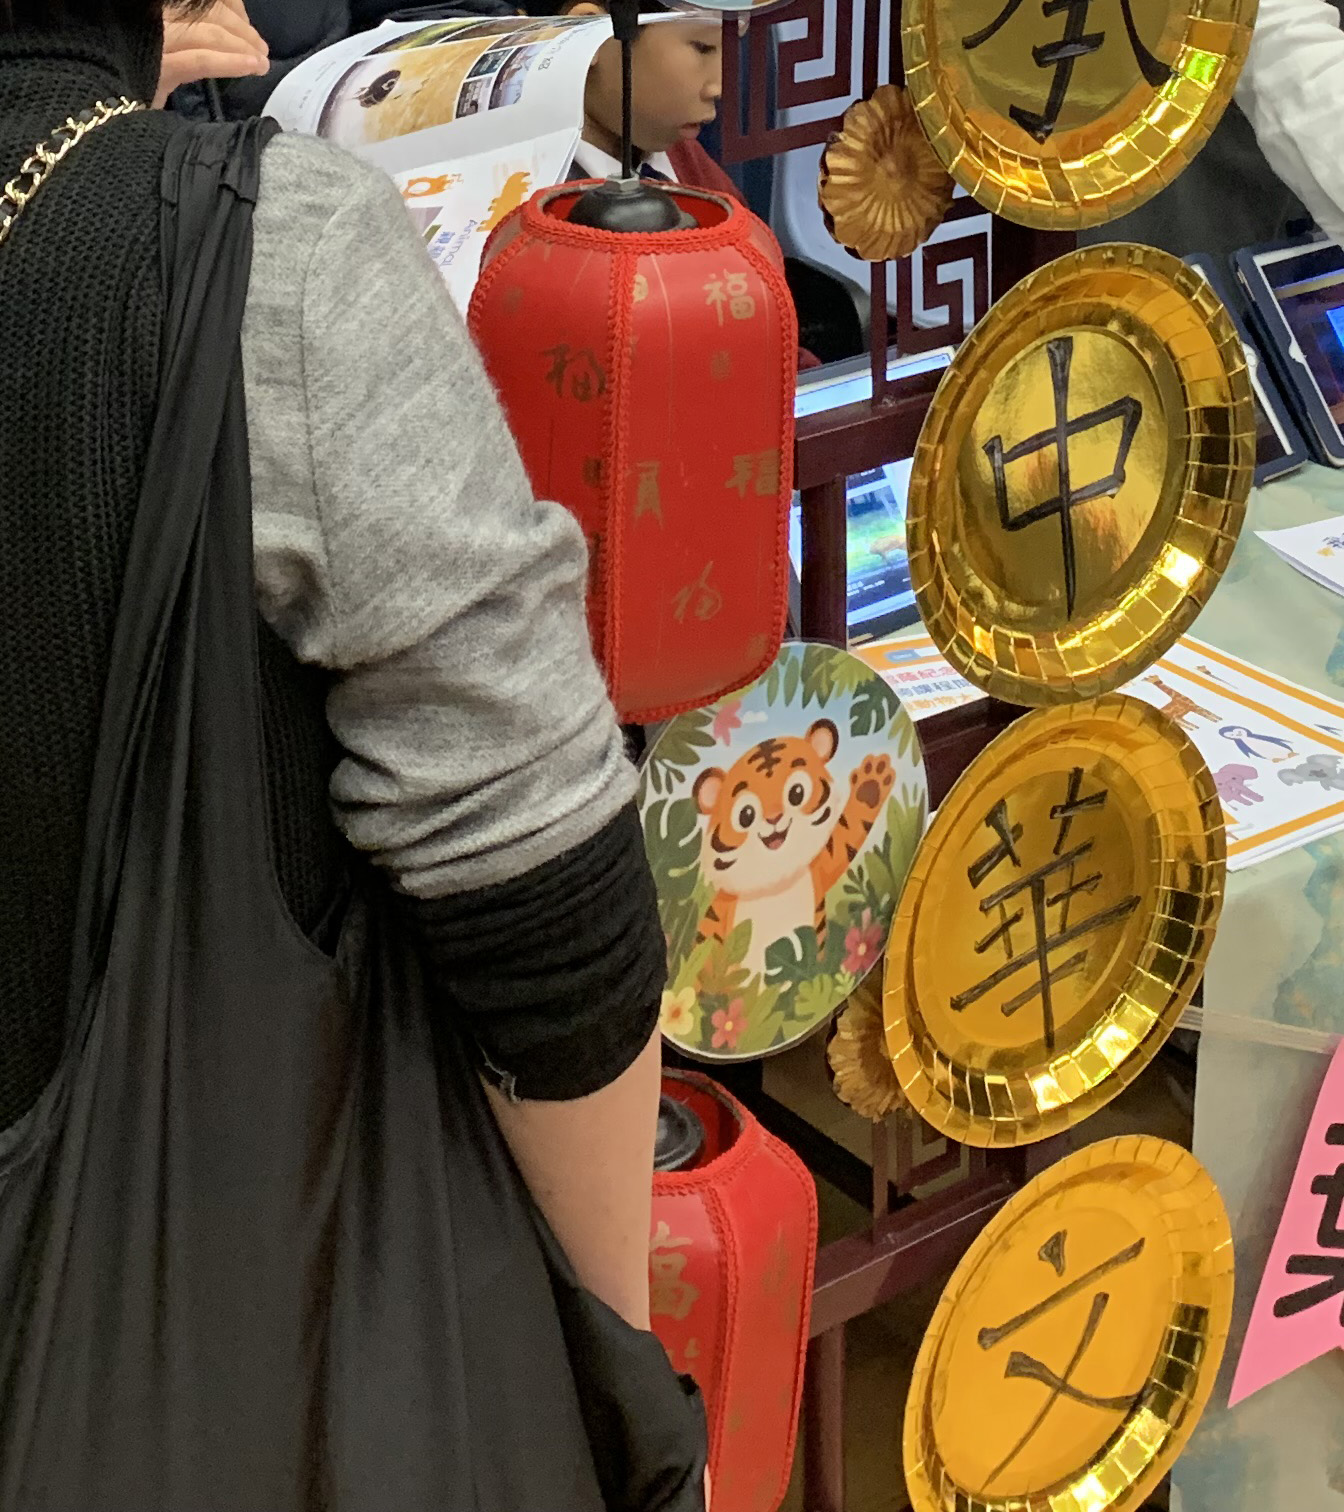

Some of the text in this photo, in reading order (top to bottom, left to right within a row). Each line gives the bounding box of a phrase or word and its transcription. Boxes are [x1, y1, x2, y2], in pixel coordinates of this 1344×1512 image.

[983, 334, 1143, 620] 中
[949, 765, 1142, 1050] 華
[976, 1228, 1148, 1496] 文
